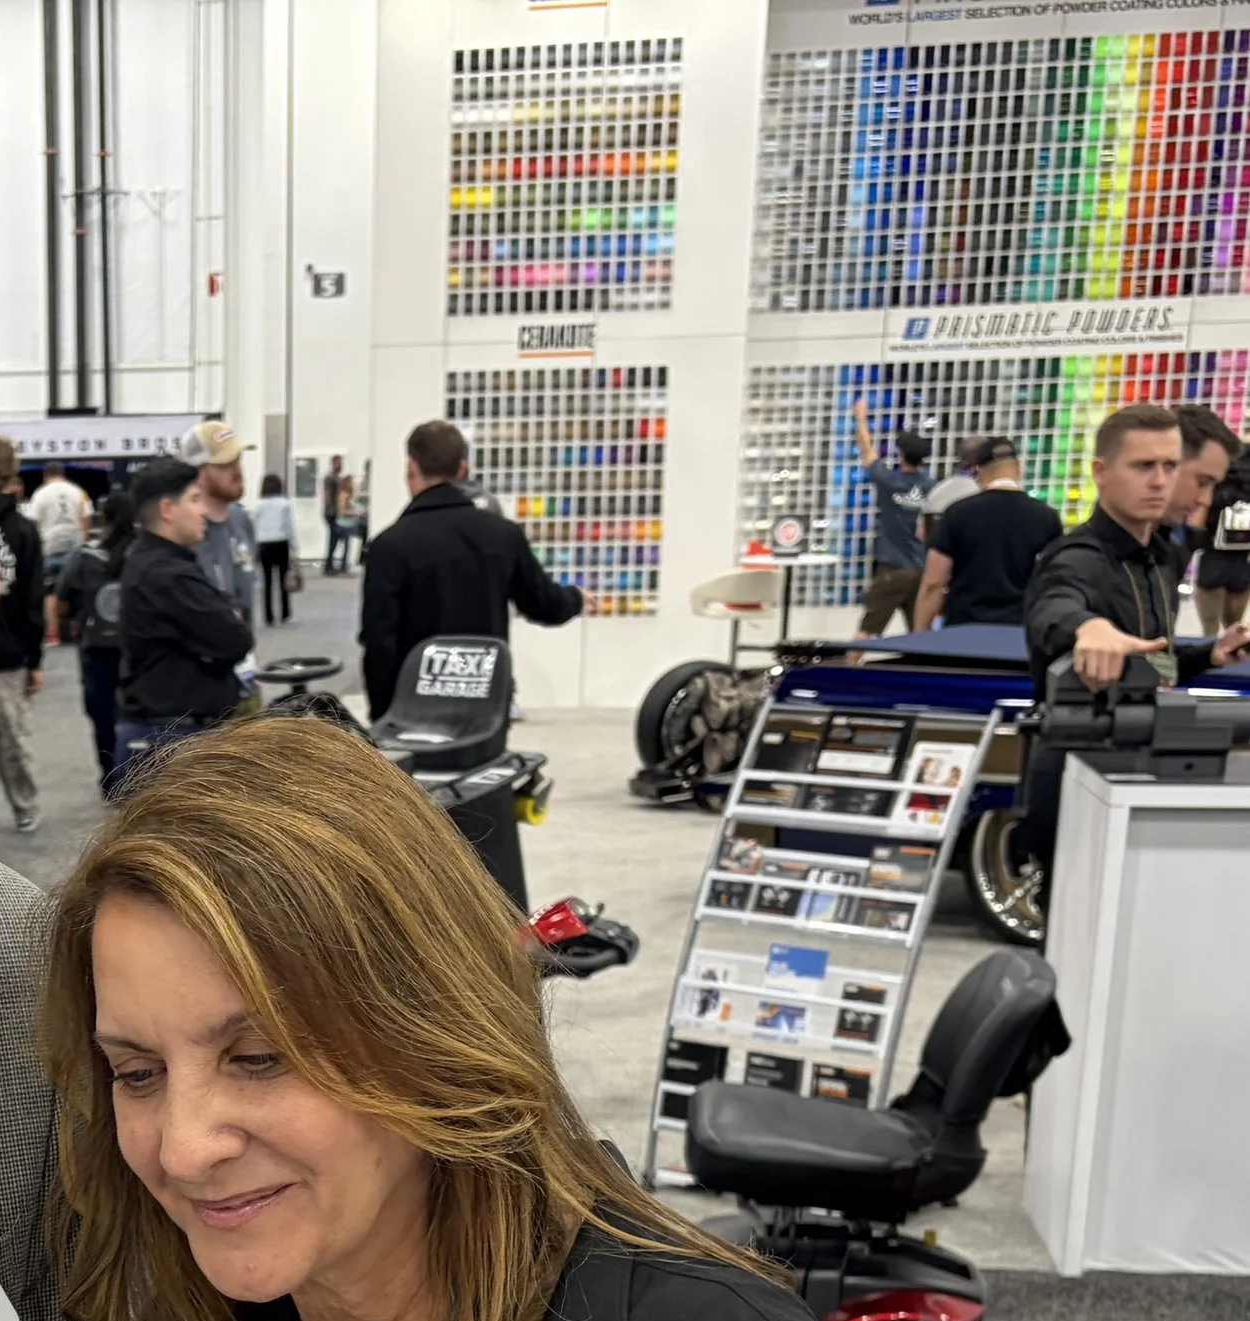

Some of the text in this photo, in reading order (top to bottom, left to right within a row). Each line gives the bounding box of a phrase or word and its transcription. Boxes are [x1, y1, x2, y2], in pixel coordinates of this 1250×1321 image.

[848, 13, 902, 25] WORLD'S
[908, 9, 962, 22] LARGEST
[965, 5, 1031, 20] SELECTION
[1034, 4, 1051, 16] OF
[1053, 2, 1107, 15] POWDER
[1110, 0, 1163, 12] COATING
[320, 279, 337, 297] 5
[933, 305, 1175, 340] PRISMATIC POWDERS
[518, 324, 595, 350] CERAKOTE
[17, 438, 107, 453] EYSTON
